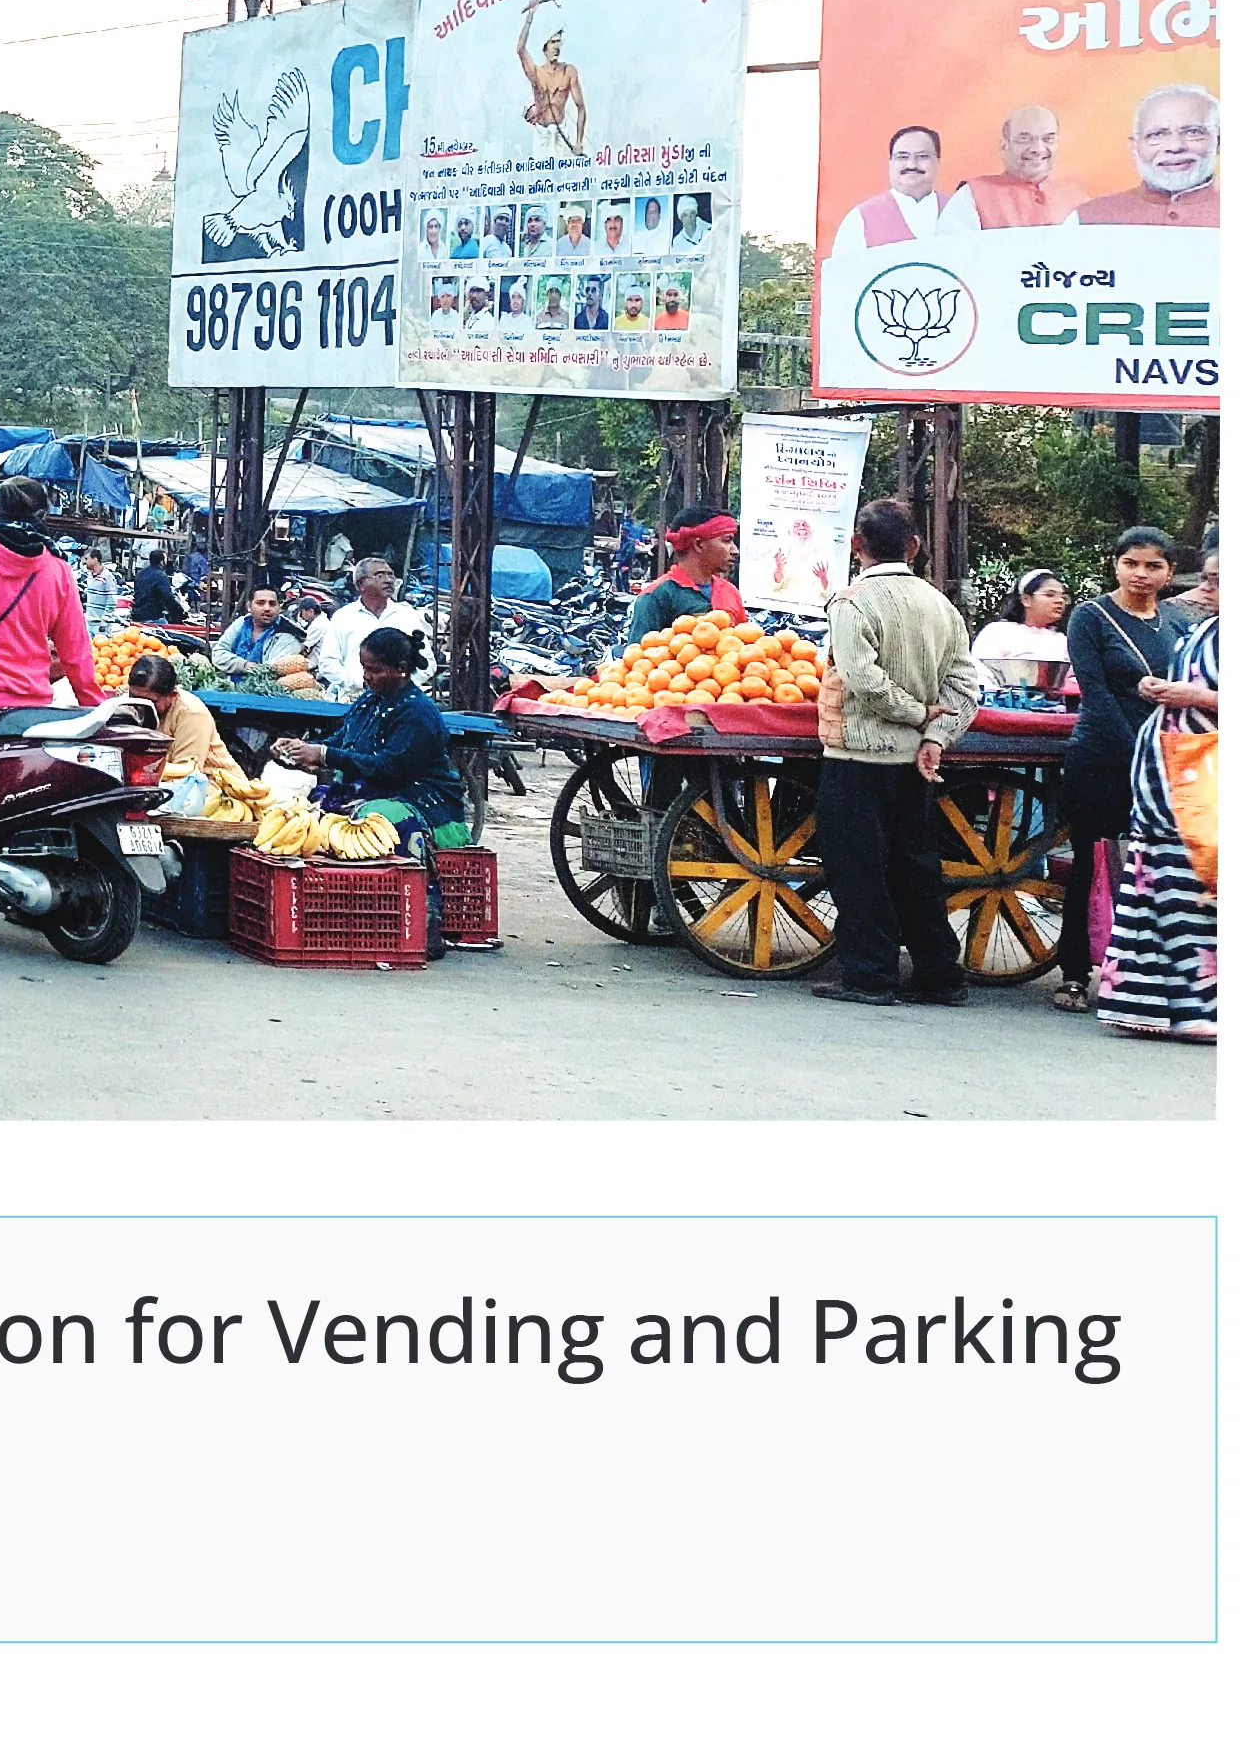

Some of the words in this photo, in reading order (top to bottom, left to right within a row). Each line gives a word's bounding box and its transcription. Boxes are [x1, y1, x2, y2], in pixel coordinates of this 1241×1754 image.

[617, 143, 655, 166] બીરસા
[1019, 261, 1117, 289] સૌજન્ય
[186, 279, 303, 352] 98796
[1017, 301, 1211, 347] CRE
[1114, 357, 1220, 386] NAVS
